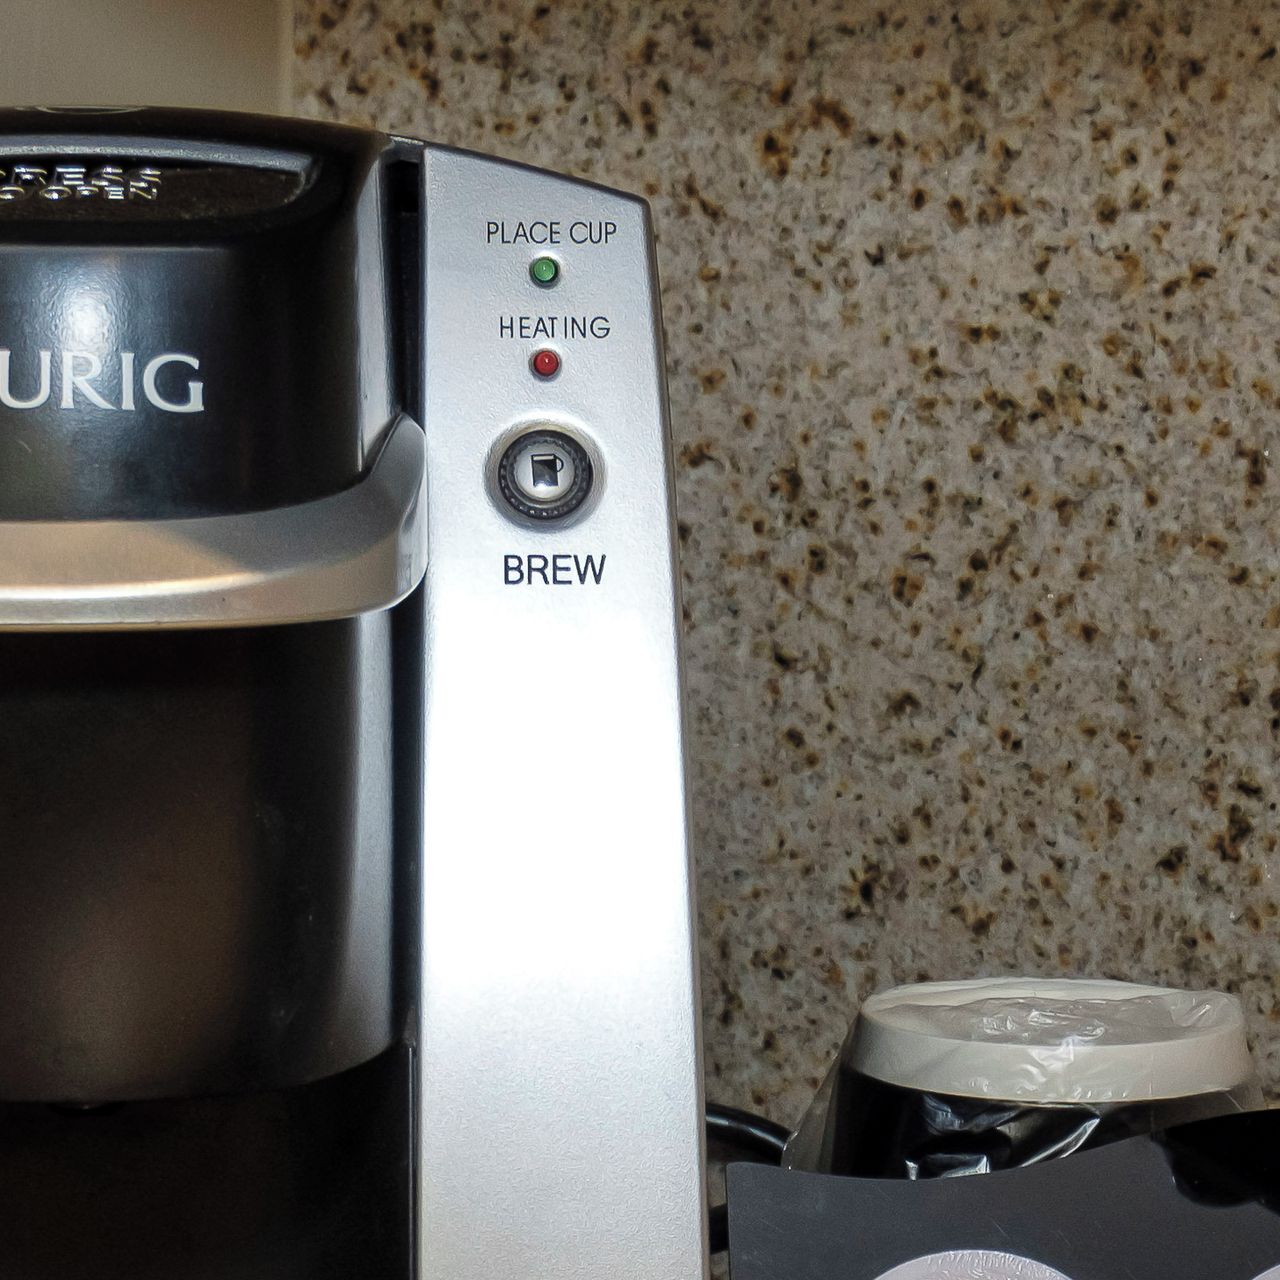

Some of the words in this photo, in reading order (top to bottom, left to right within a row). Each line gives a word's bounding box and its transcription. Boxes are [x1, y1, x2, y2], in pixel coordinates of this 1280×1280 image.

[39, 185, 158, 200] OPEN
[486, 221, 561, 244] PLACE
[569, 221, 617, 244] CUP
[499, 316, 611, 339] HEATING
[503, 554, 607, 585] BREW
